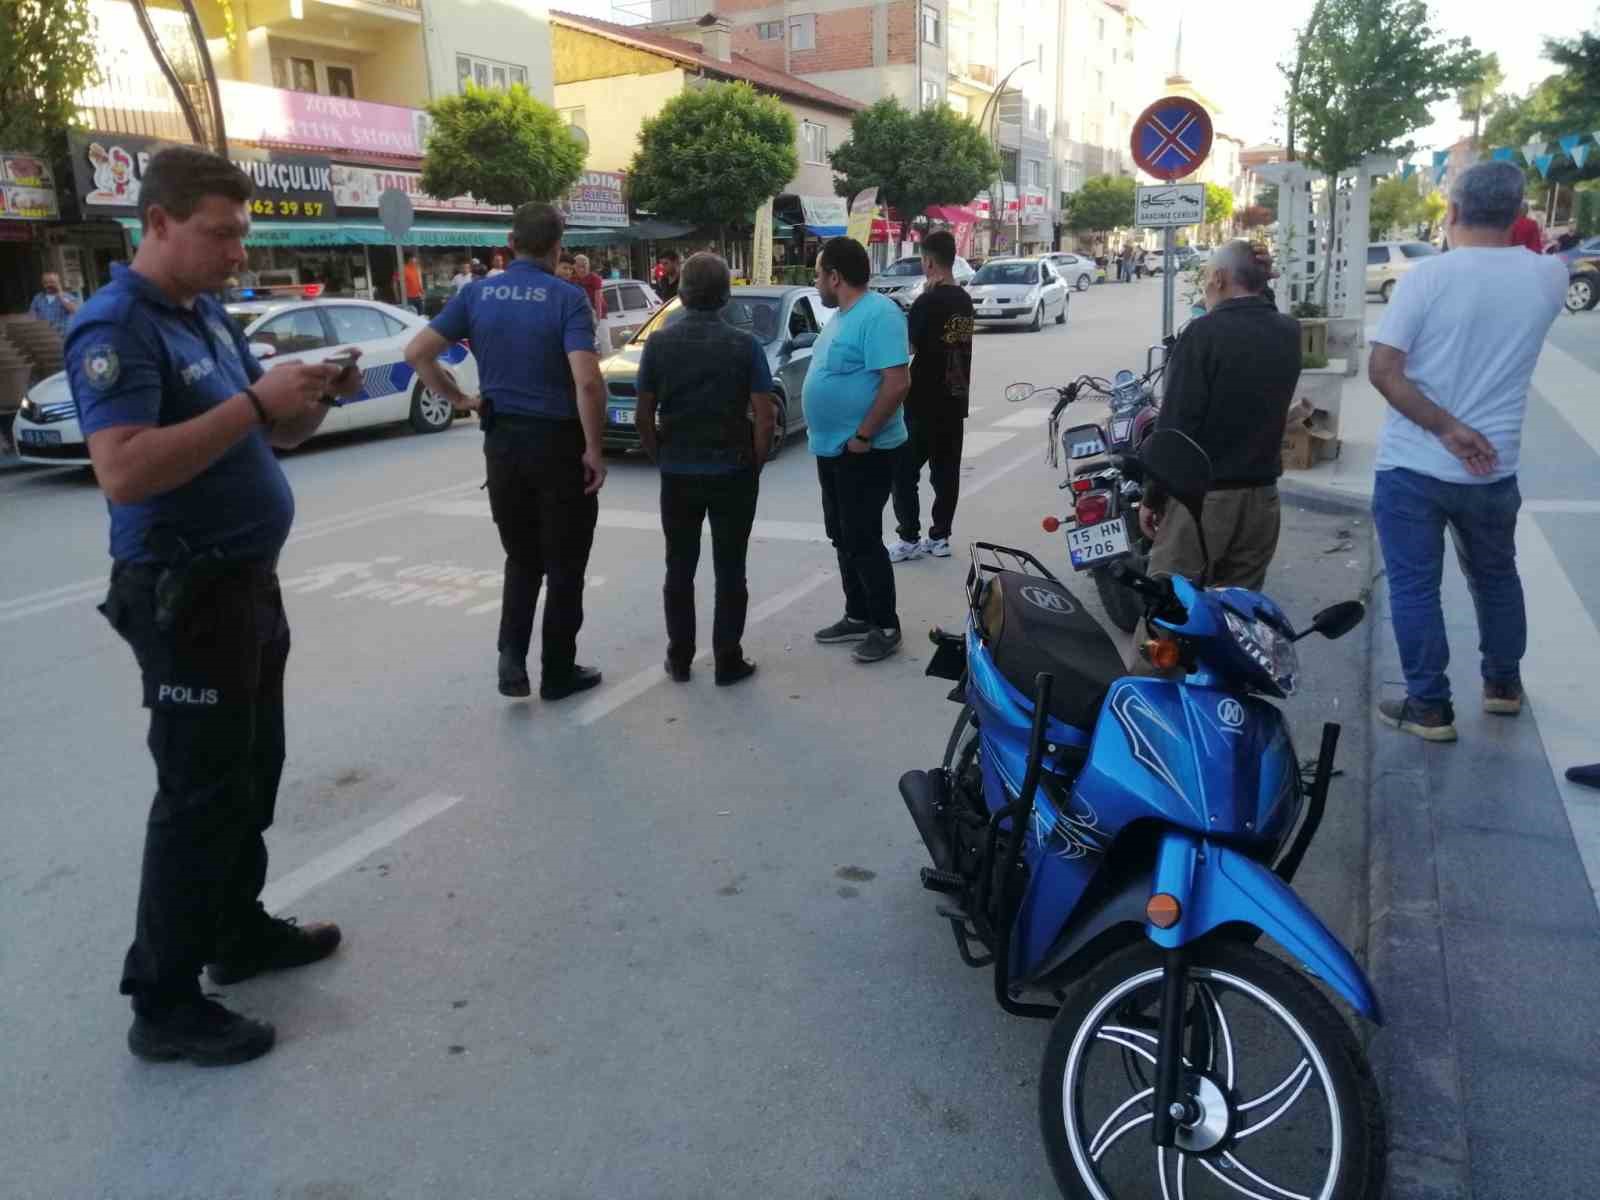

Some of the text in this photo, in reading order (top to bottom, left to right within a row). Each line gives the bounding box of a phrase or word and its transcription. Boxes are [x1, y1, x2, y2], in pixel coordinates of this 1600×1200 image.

[573, 172, 622, 191] ADIM
[279, 201, 299, 216] 39
[303, 202, 324, 216] 57
[1072, 521, 1122, 545] 15 HN
[1083, 540, 1115, 558] 706
